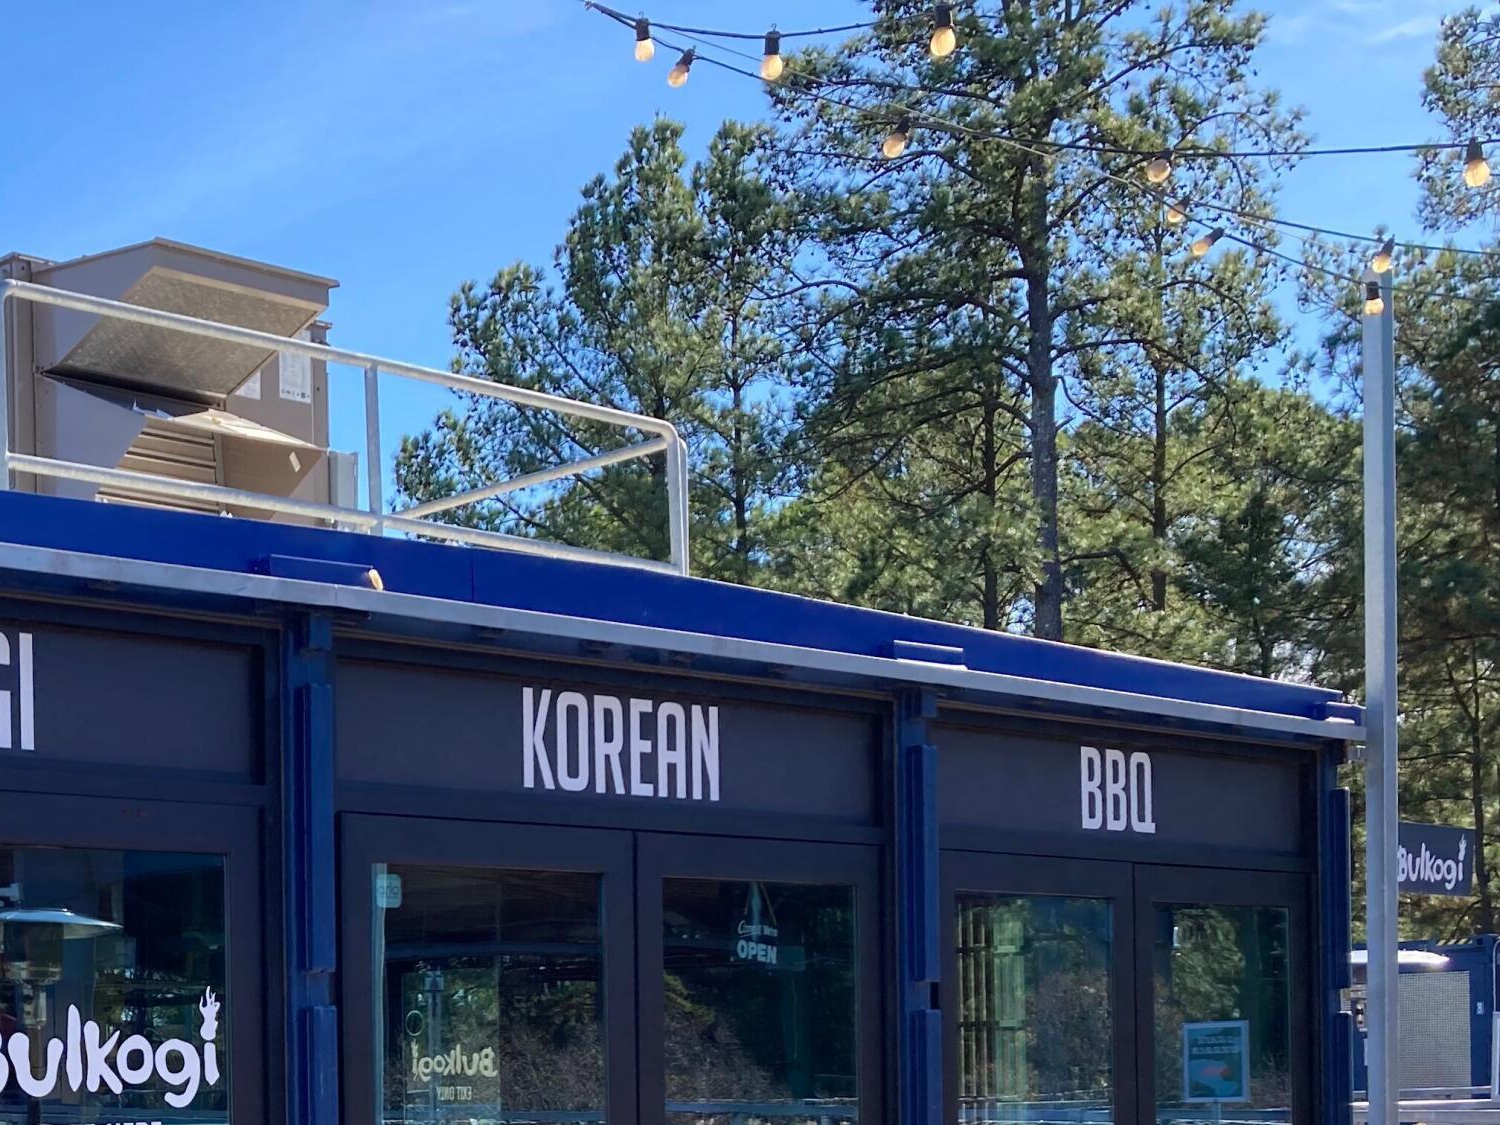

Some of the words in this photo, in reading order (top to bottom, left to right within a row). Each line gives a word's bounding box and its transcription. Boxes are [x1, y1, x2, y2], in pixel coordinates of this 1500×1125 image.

[522, 687, 720, 801] KOREAN
[1080, 746, 1156, 834] BBQ
[1396, 834, 1467, 890] Bulkogi
[737, 939, 778, 965] OPEN
